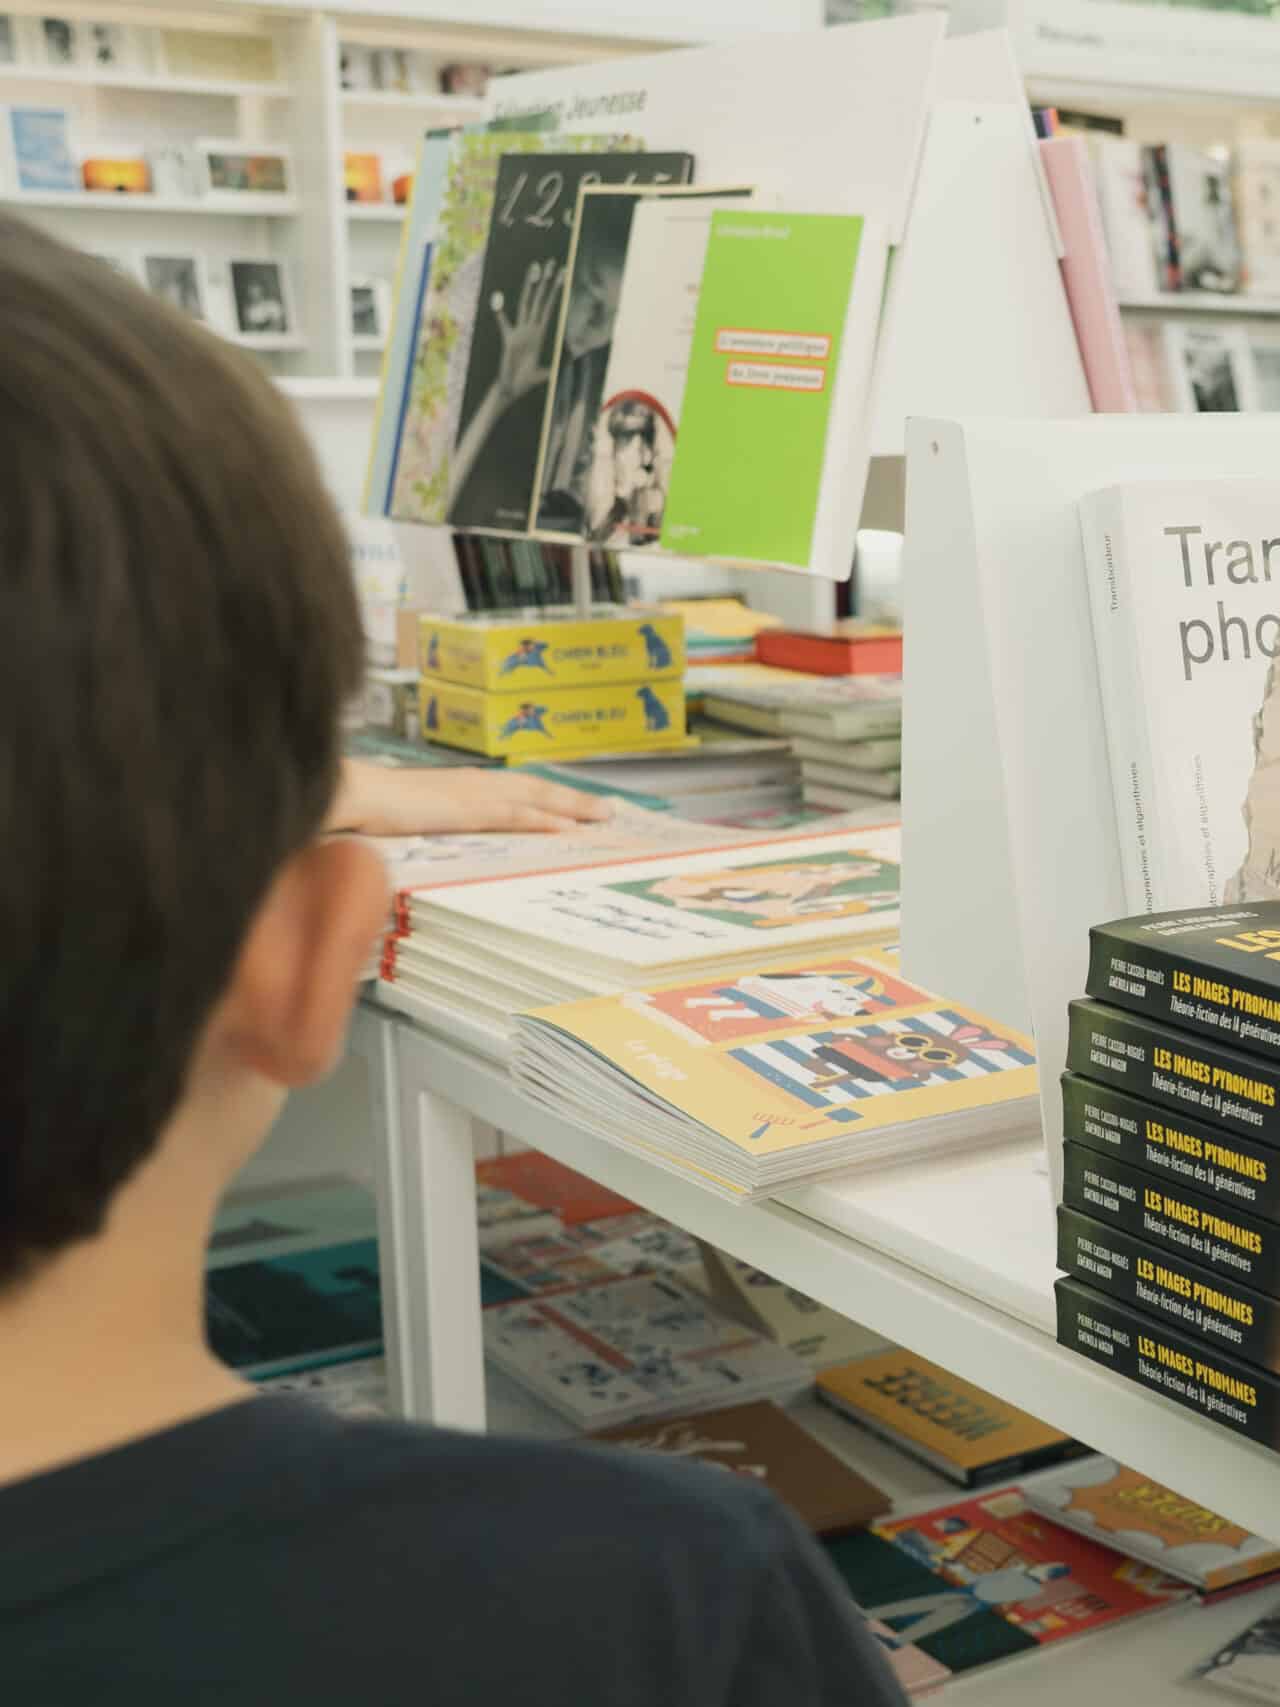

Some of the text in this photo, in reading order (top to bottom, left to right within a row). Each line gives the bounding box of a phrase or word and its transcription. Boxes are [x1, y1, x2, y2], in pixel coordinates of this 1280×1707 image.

[1170, 995, 1219, 1025] Théorie-fiction
[1219, 1009, 1232, 1029] des
[1173, 970, 1191, 993] LES
[1193, 977, 1230, 1006] IMAGES
[1152, 1072, 1200, 1102] Théorie-fiction
[1200, 1088, 1213, 1107] des
[1222, 1098, 1263, 1126] génératives
[1154, 1047, 1275, 1107] LES IMAGES PYROMANES
[1146, 1119, 1267, 1182] LES IMAGES PYROMANES
[1146, 1144, 1193, 1177] Théorie-fiction
[1194, 1163, 1206, 1182] des
[1215, 1173, 1256, 1201] génératives
[1144, 1188, 1262, 1255] LES IMAGES PYROMANES
[1144, 1212, 1190, 1246] Théorie-fiction
[1191, 1232, 1203, 1251] des
[1211, 1241, 1252, 1272] génératives
[1136, 1257, 1254, 1326] LES IMAGES PYROMANES
[1136, 1281, 1182, 1316] Théorie-fiction
[1183, 1301, 1195, 1321] des
[1203, 1311, 1242, 1344] génératives
[1137, 1335, 1256, 1407] LES IMAGES PYROMANES
[1139, 1358, 1185, 1393] Théorie-fiction
[1187, 1380, 1199, 1401] des
[1207, 1391, 1247, 1424] génératives
